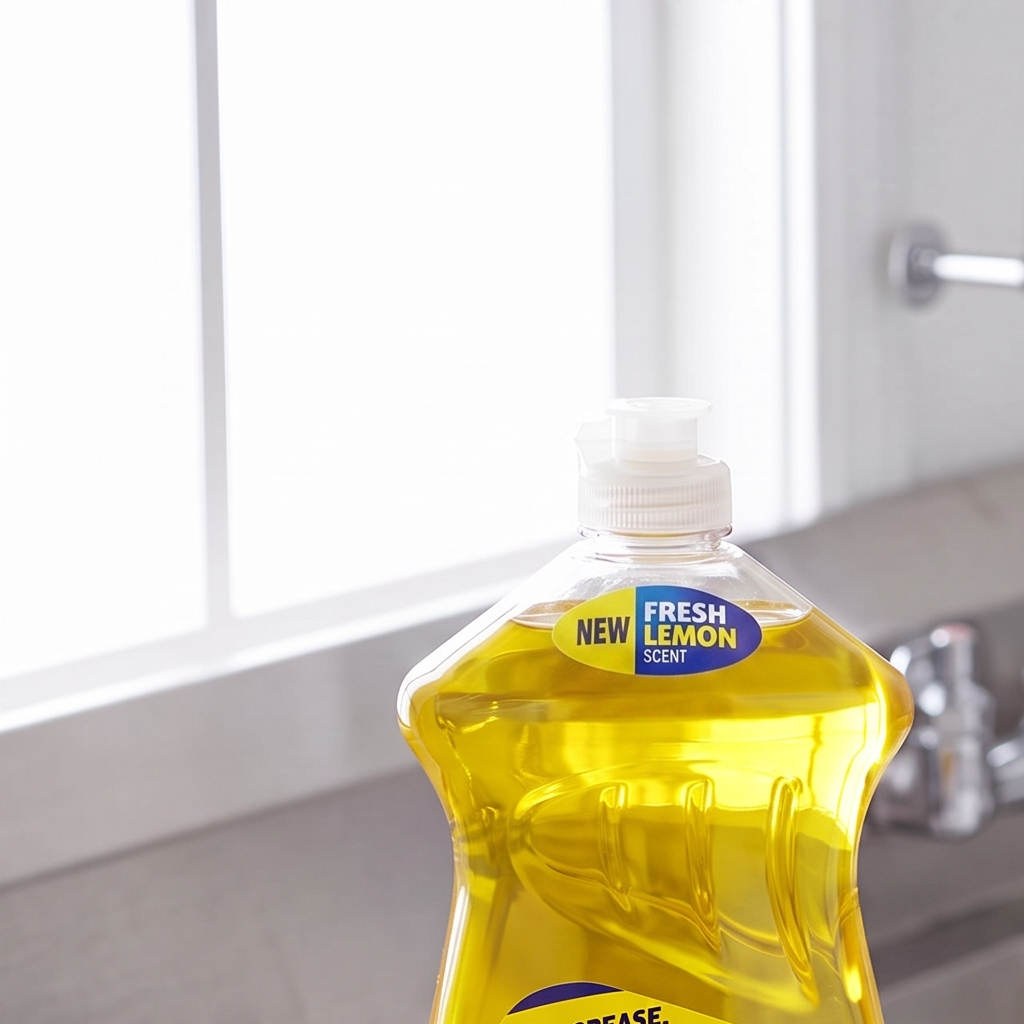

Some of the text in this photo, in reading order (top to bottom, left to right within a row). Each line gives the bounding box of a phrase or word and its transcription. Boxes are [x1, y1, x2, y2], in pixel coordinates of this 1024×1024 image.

[644, 601, 727, 625] FRESH
[576, 615, 631, 646] NEW
[643, 624, 737, 649] LEMON
[643, 649, 688, 664] SCENT
